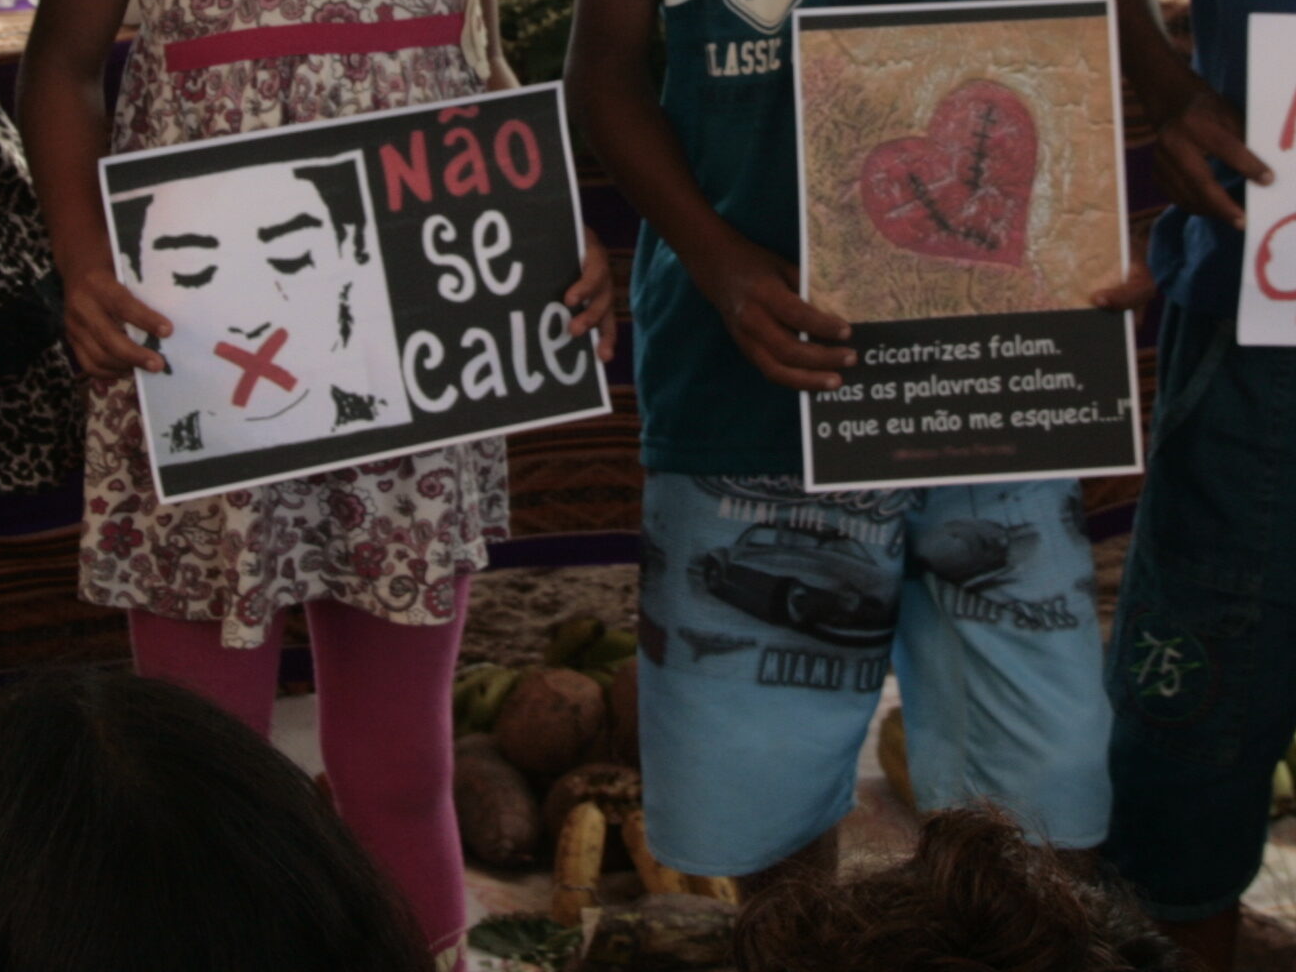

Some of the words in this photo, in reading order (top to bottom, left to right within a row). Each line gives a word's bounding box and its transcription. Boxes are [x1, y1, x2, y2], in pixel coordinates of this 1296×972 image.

[864, 337, 981, 366] cicatrizes
[988, 334, 1062, 361] falam.
[870, 380, 897, 401] as
[903, 374, 1001, 404] palavras
[817, 420, 832, 439] o
[838, 419, 880, 443] que
[886, 415, 915, 435] eu
[921, 409, 963, 433] não
[969, 411, 1004, 429] me
